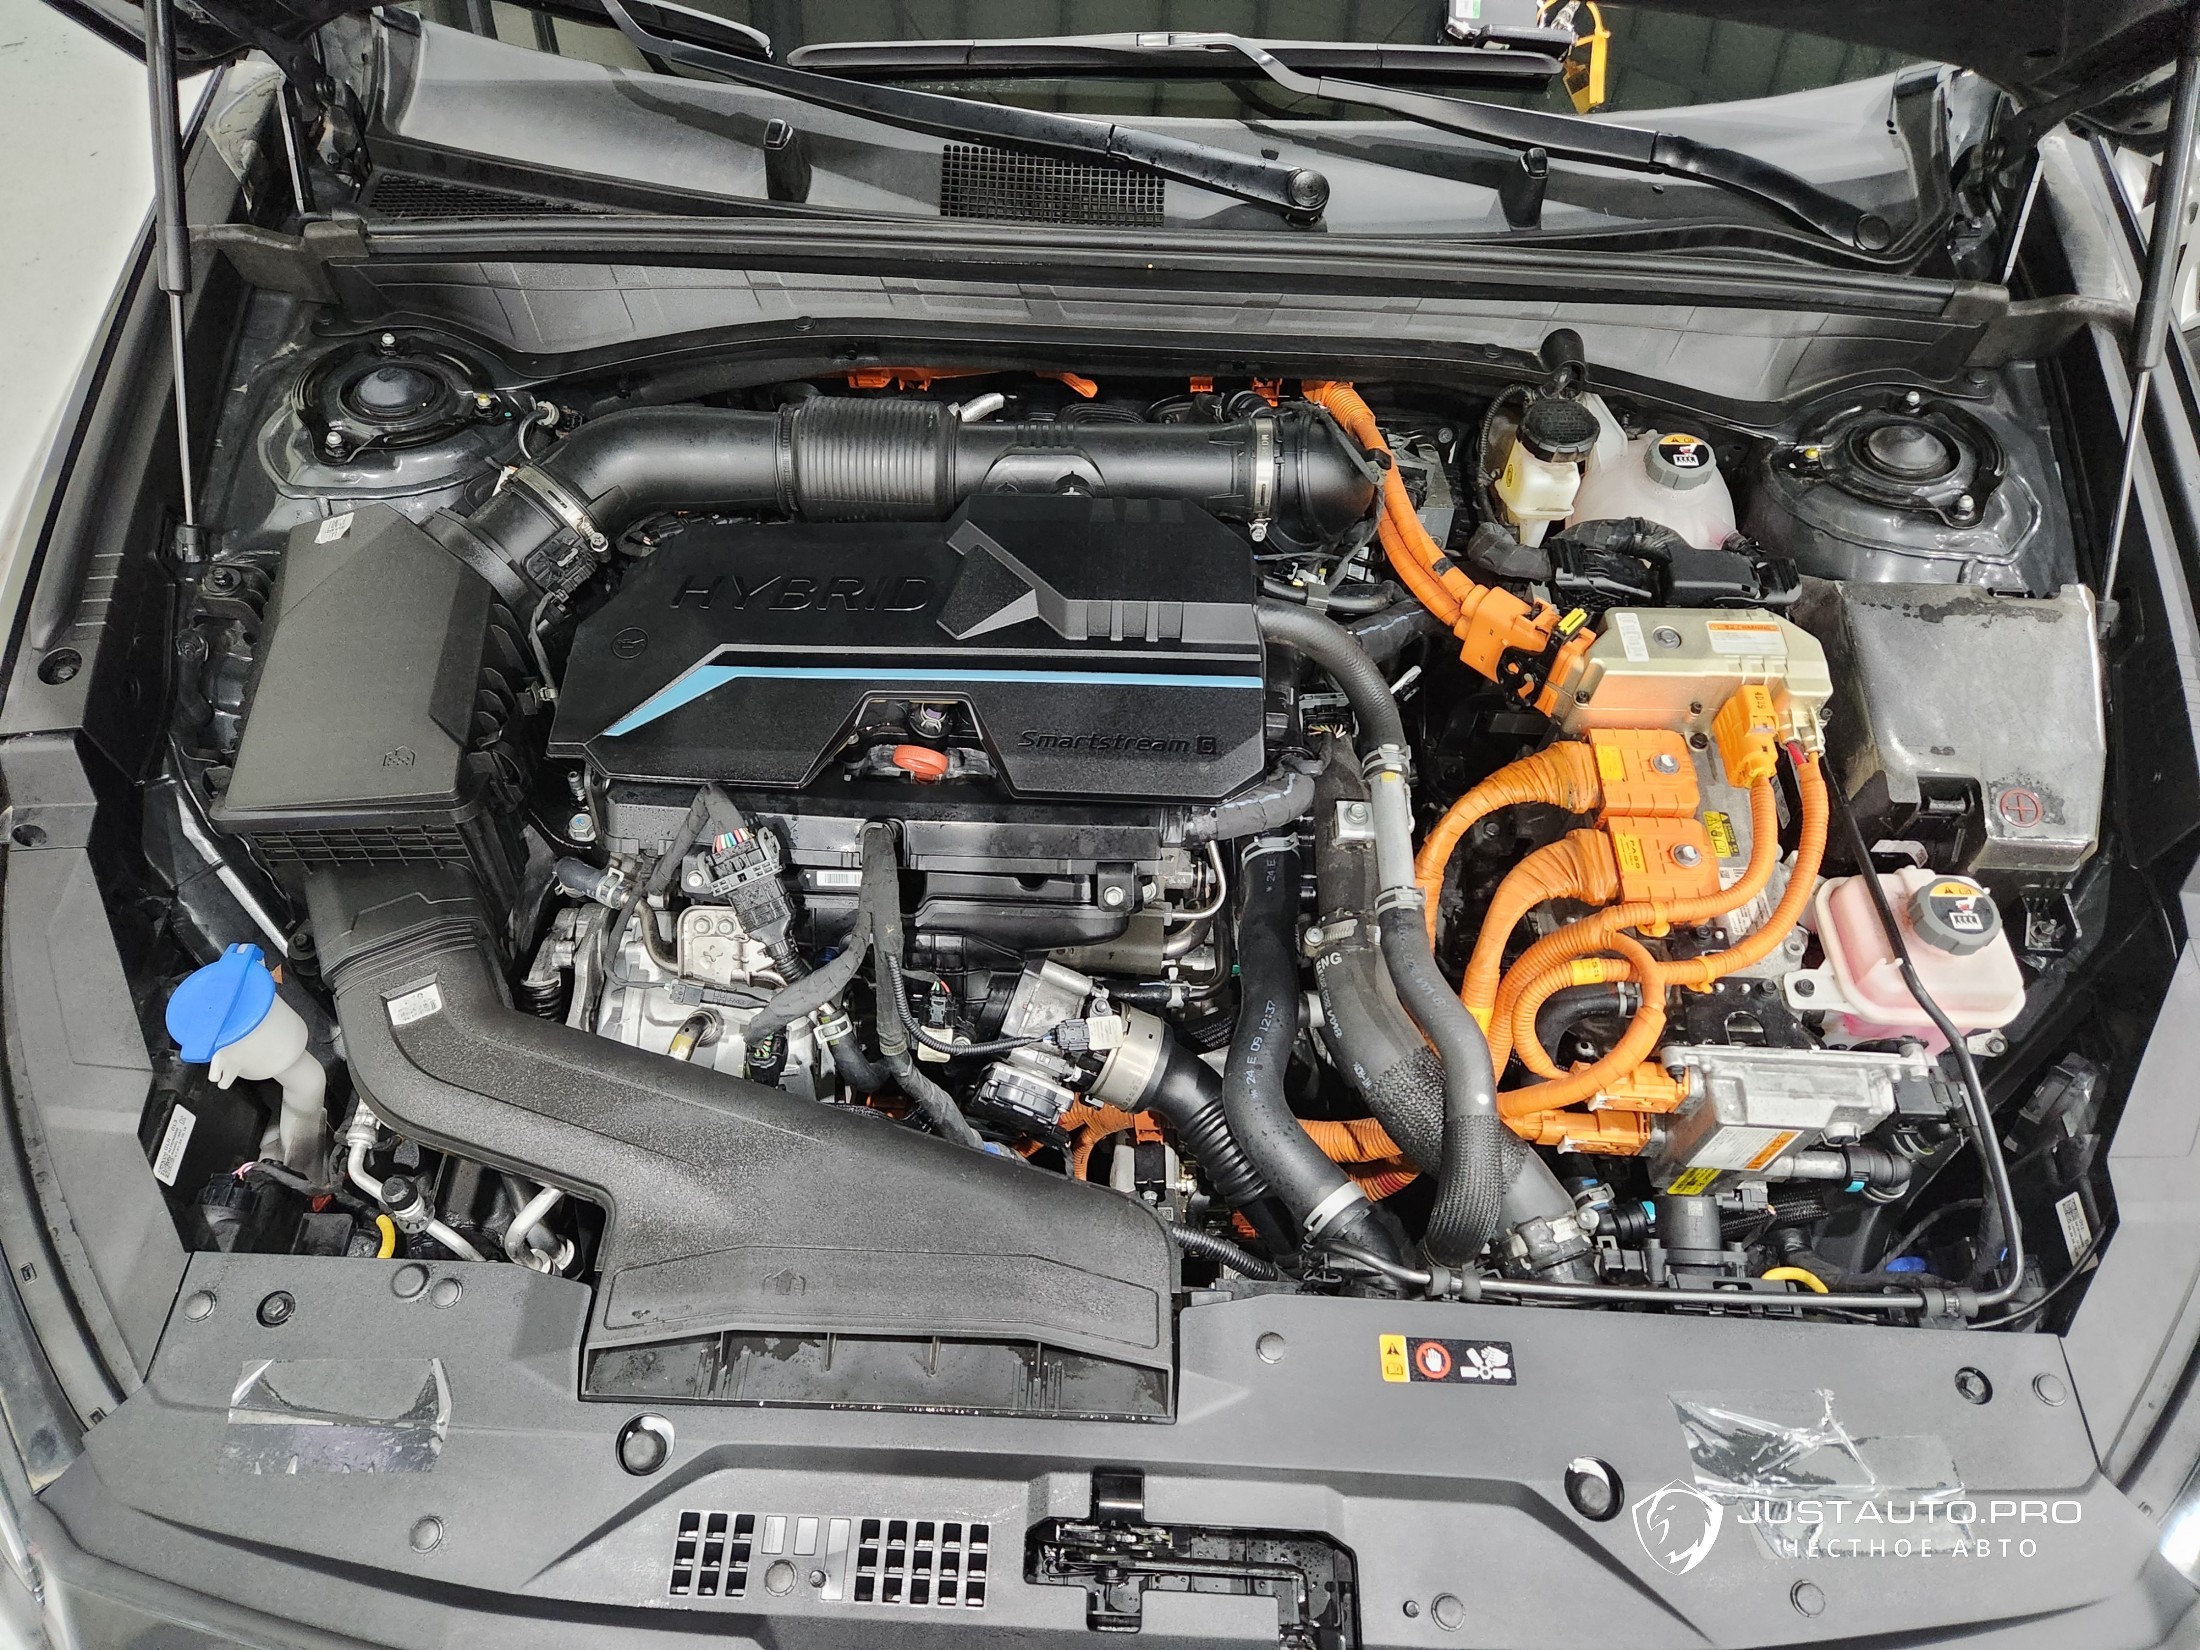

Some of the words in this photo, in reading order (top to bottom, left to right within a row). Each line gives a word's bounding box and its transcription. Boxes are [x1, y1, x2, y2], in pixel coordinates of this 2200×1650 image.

[669, 574, 931, 612] HYBRID
[1018, 729, 1191, 753] Smartstream
[1315, 952, 1343, 975] ENG
[1259, 1000, 1276, 1032] 12:37
[1250, 1036, 1263, 1052] 09
[1247, 1055, 1257, 1064] E
[1246, 1070, 1257, 1085] 24
